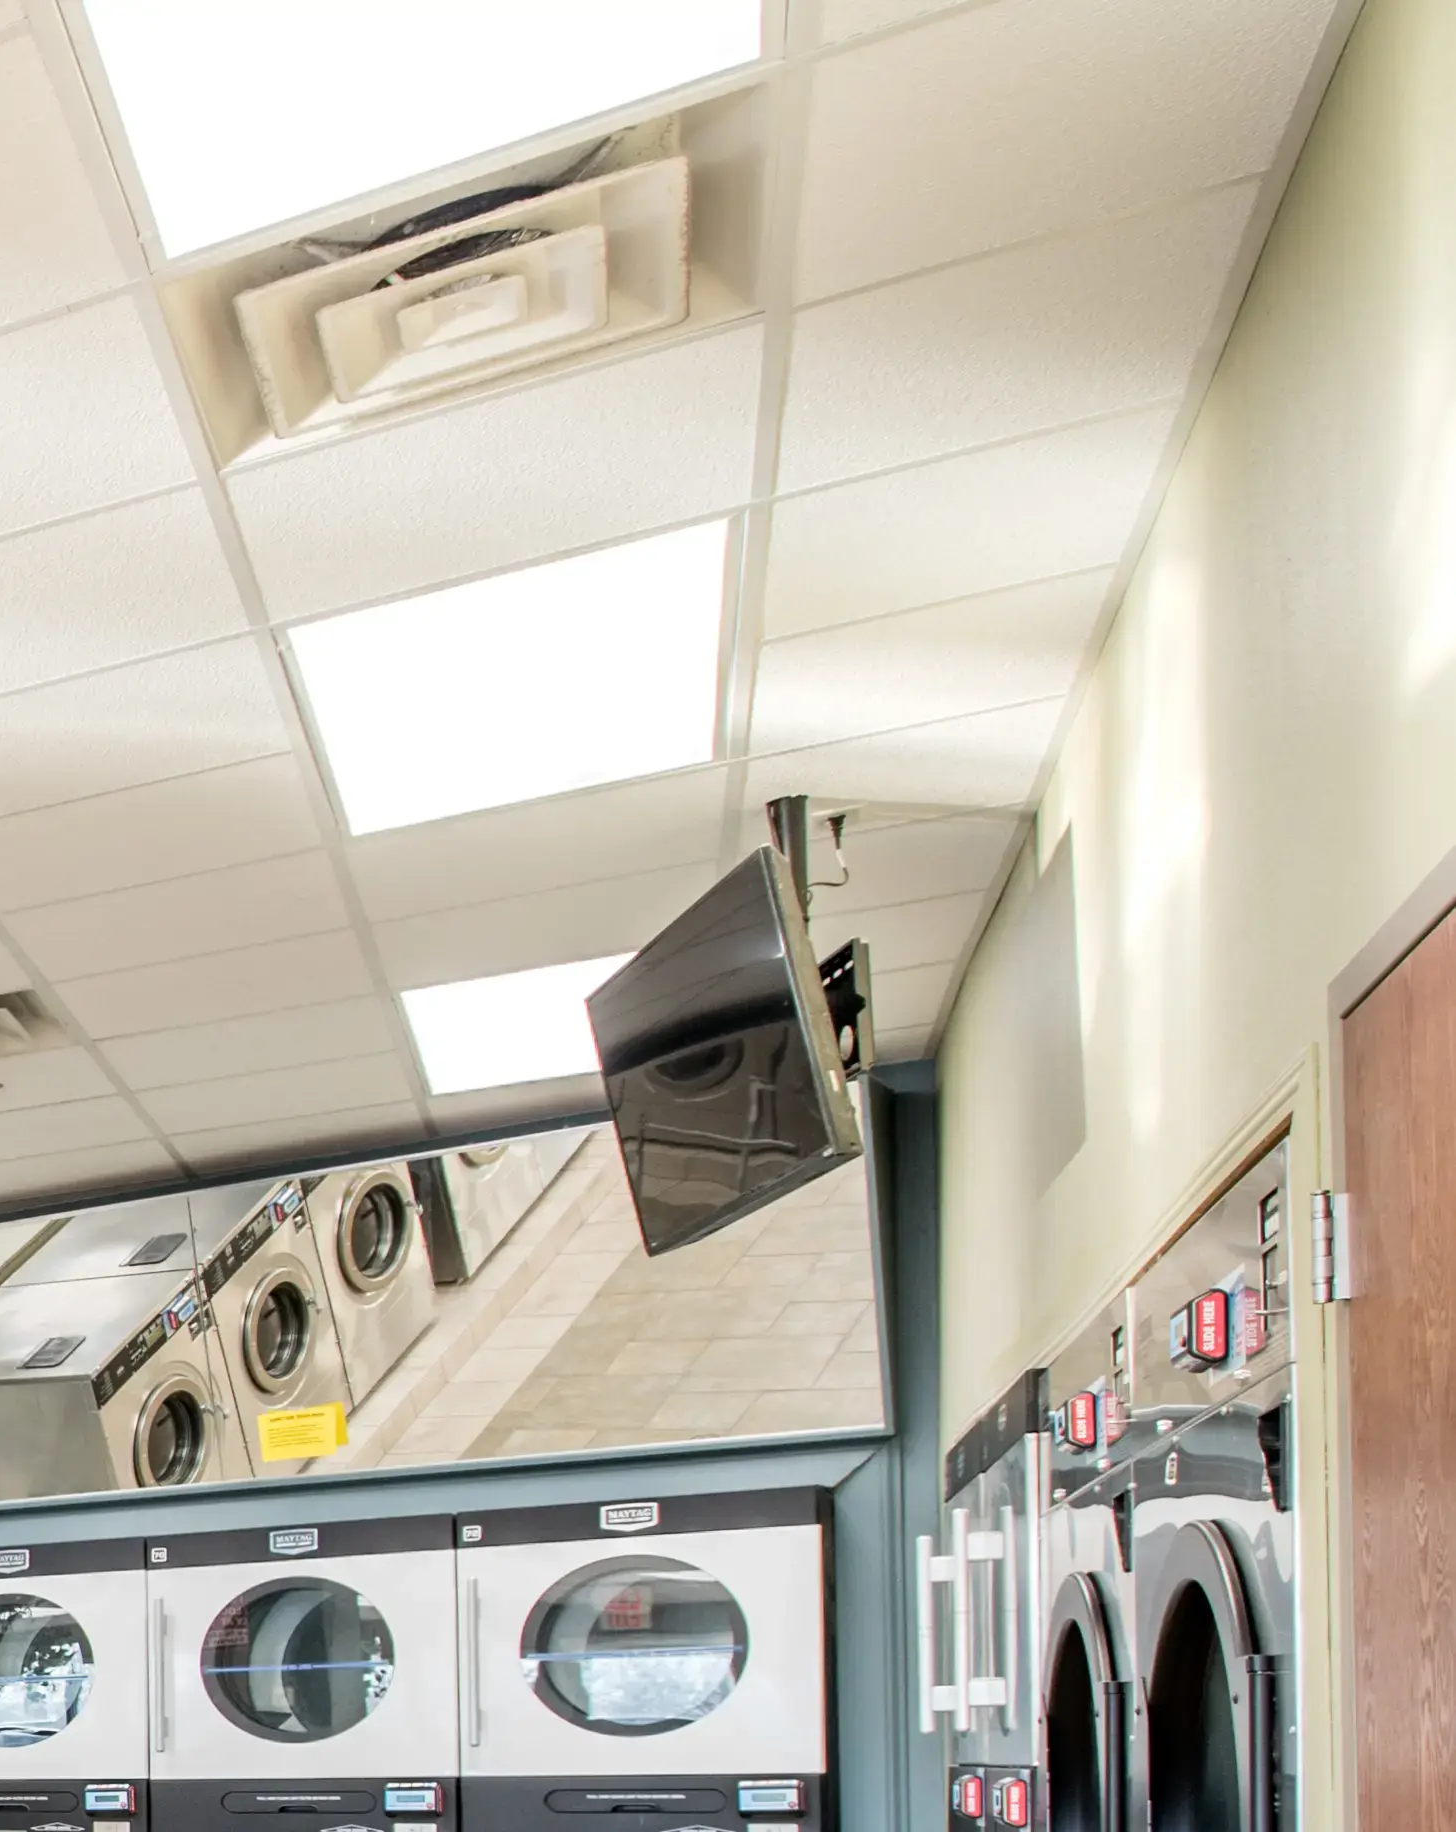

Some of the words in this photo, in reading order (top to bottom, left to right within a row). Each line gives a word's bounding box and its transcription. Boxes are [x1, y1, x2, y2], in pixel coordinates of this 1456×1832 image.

[1202, 1300, 1215, 1324] HERE
[1202, 1326, 1215, 1351] SLIDE
[608, 1508, 652, 1520] MAYTAG
[275, 1534, 313, 1544] MAYTAG
